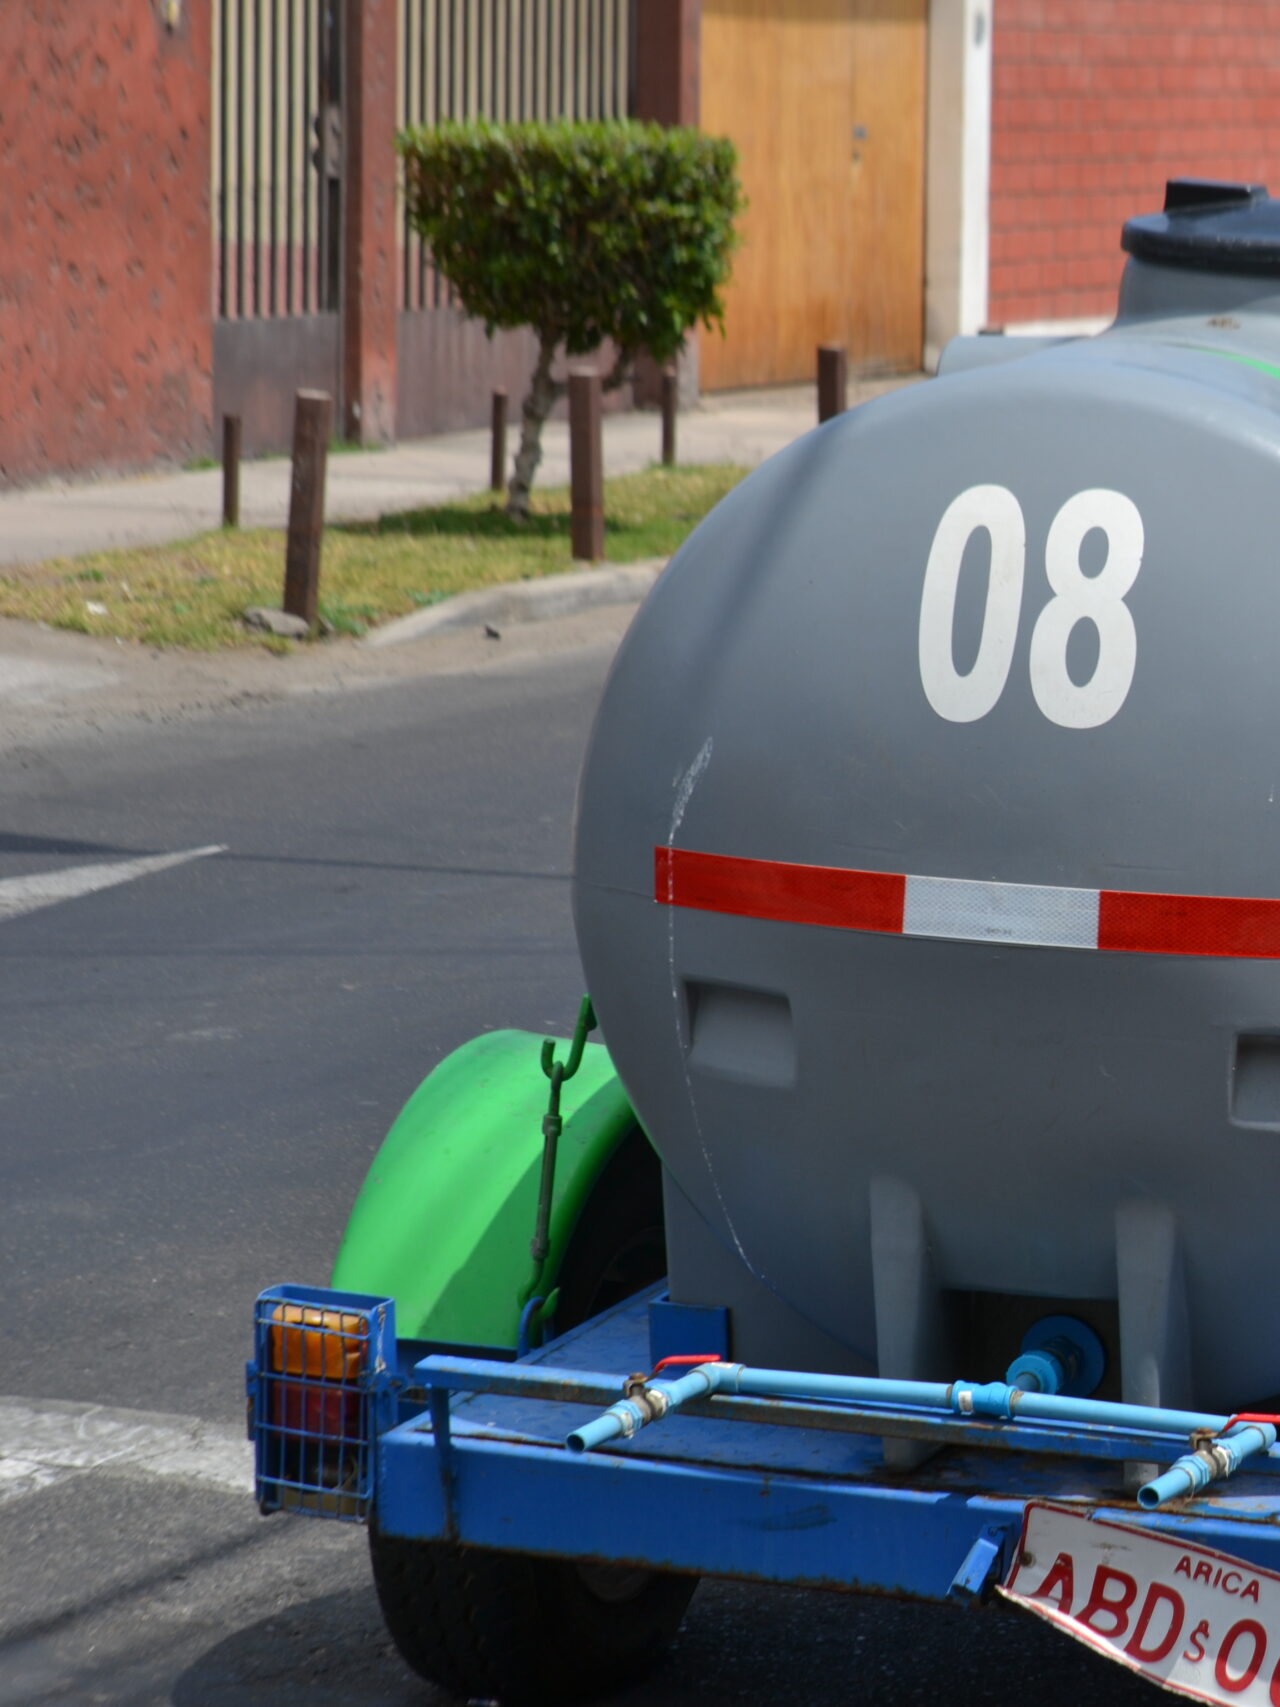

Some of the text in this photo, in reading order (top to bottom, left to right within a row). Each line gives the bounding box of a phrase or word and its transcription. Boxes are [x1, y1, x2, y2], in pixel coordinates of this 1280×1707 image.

[918, 483, 1145, 729] 08
[1027, 1552, 1185, 1663] ABD
[1173, 1554, 1261, 1604] ARICA
